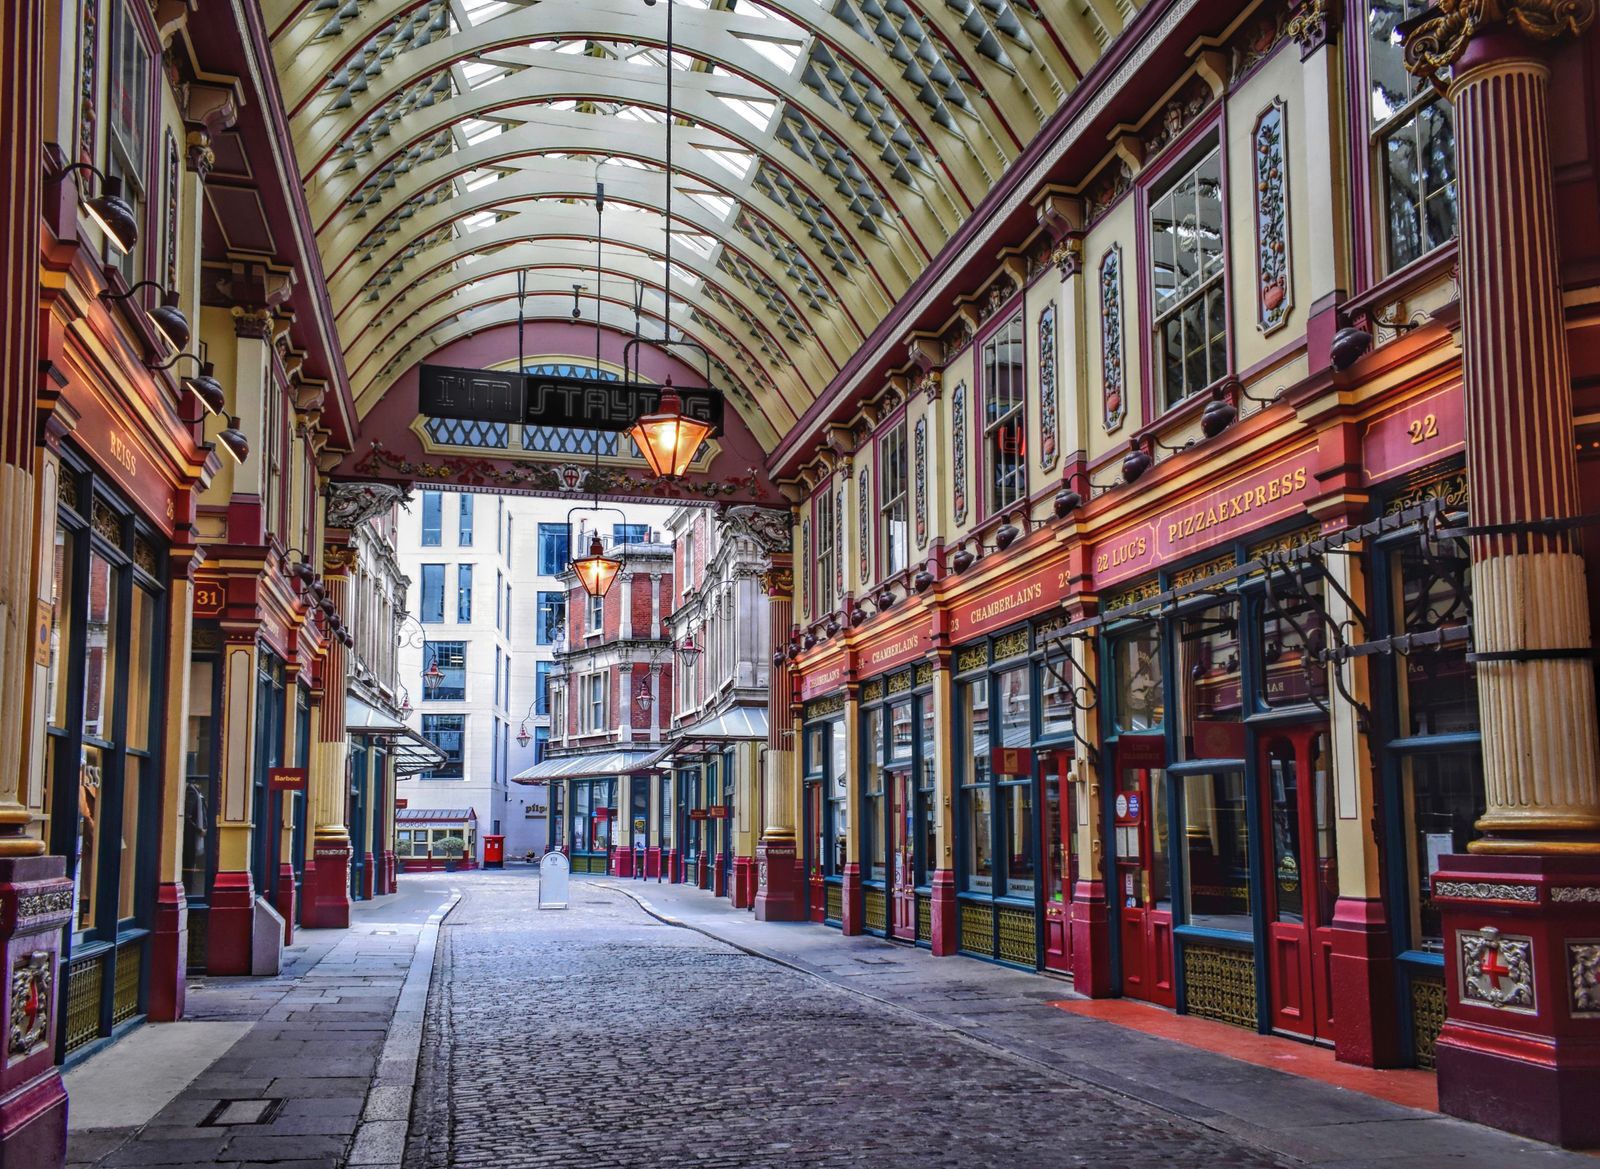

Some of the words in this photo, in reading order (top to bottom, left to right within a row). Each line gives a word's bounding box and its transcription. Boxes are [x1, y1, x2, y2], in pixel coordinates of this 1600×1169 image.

[1410, 414, 1439, 445] 22
[110, 430, 136, 477] REISS
[1168, 467, 1307, 543] PIZZAEXPRESS
[1096, 556, 1109, 573] 22
[1112, 537, 1147, 566] LUC'S
[197, 590, 218, 606] 31
[950, 619, 960, 632] 23
[970, 583, 1042, 624] CHAMBERLAIN'S
[872, 634, 919, 664] CHAMBERLAIN'S
